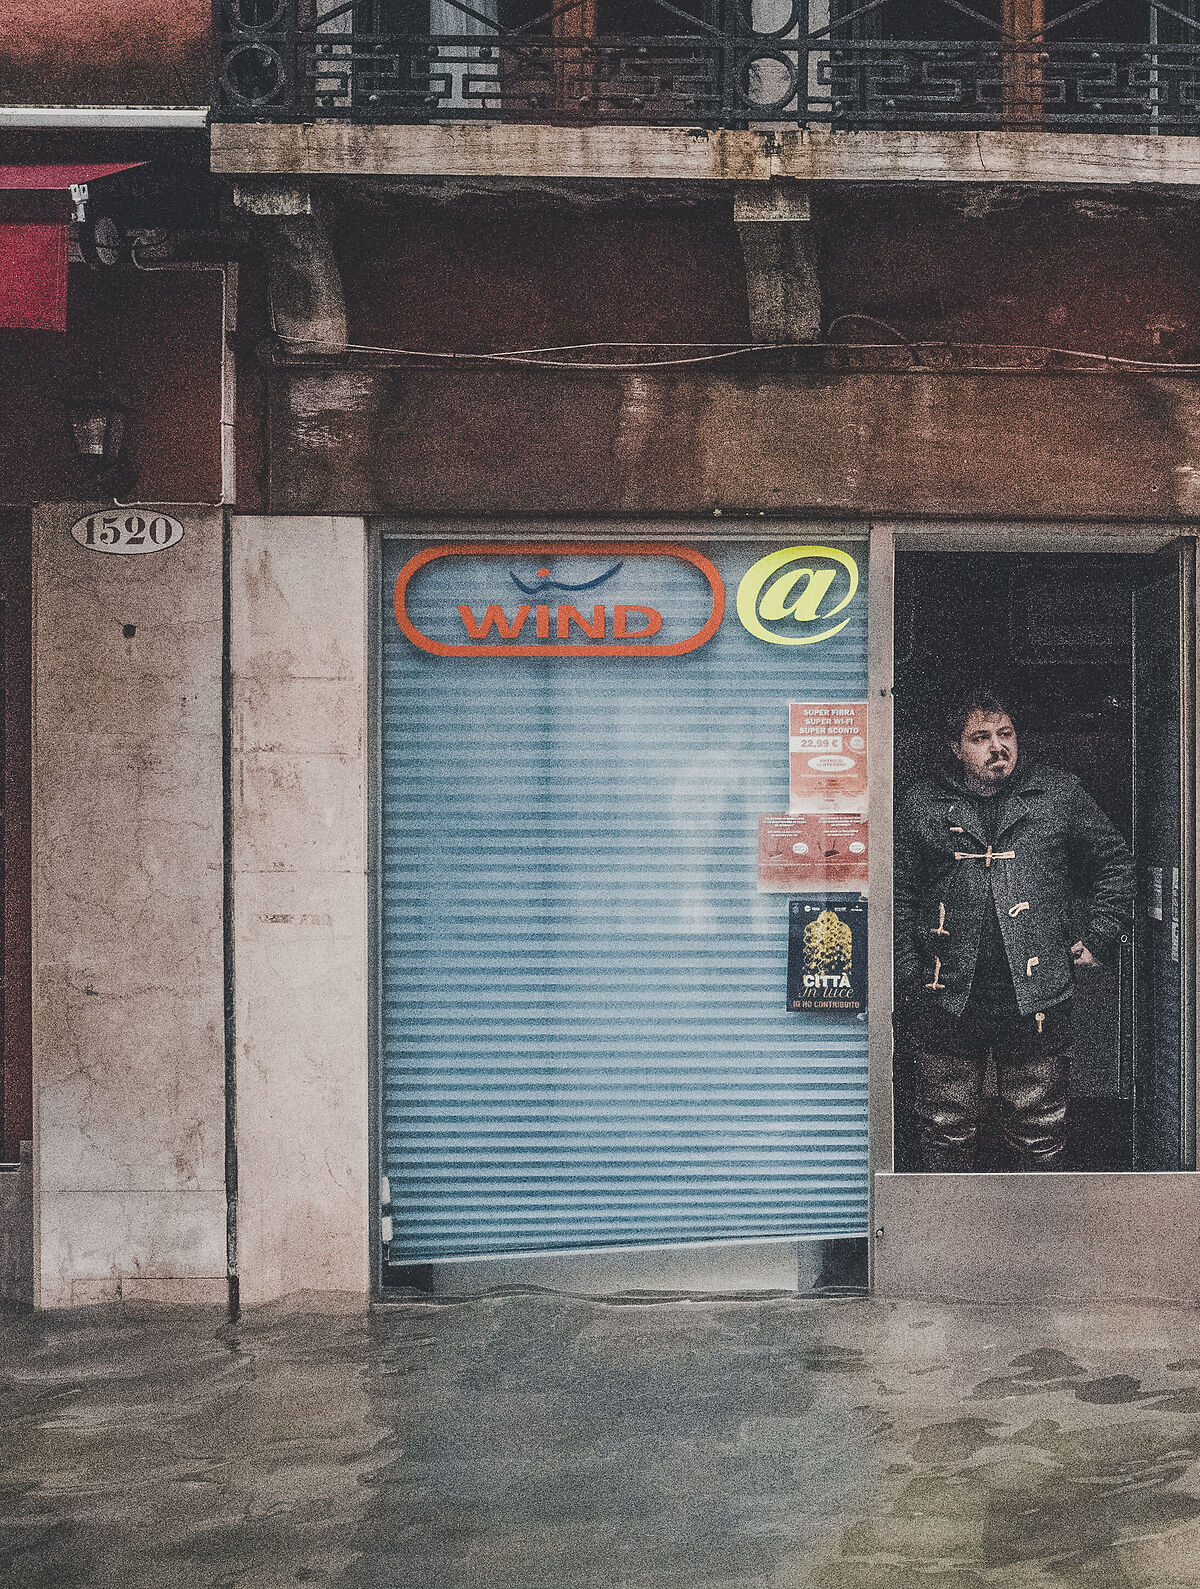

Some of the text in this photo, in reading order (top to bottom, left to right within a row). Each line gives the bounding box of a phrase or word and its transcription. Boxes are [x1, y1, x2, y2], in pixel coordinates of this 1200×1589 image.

[85, 516, 173, 545] 1520
[736, 545, 859, 646] @
[457, 604, 663, 639] WIND
[802, 972, 851, 988] CITTÀ
[822, 985, 855, 999] luce
[814, 1001, 860, 1009] CONTRIBUTO
